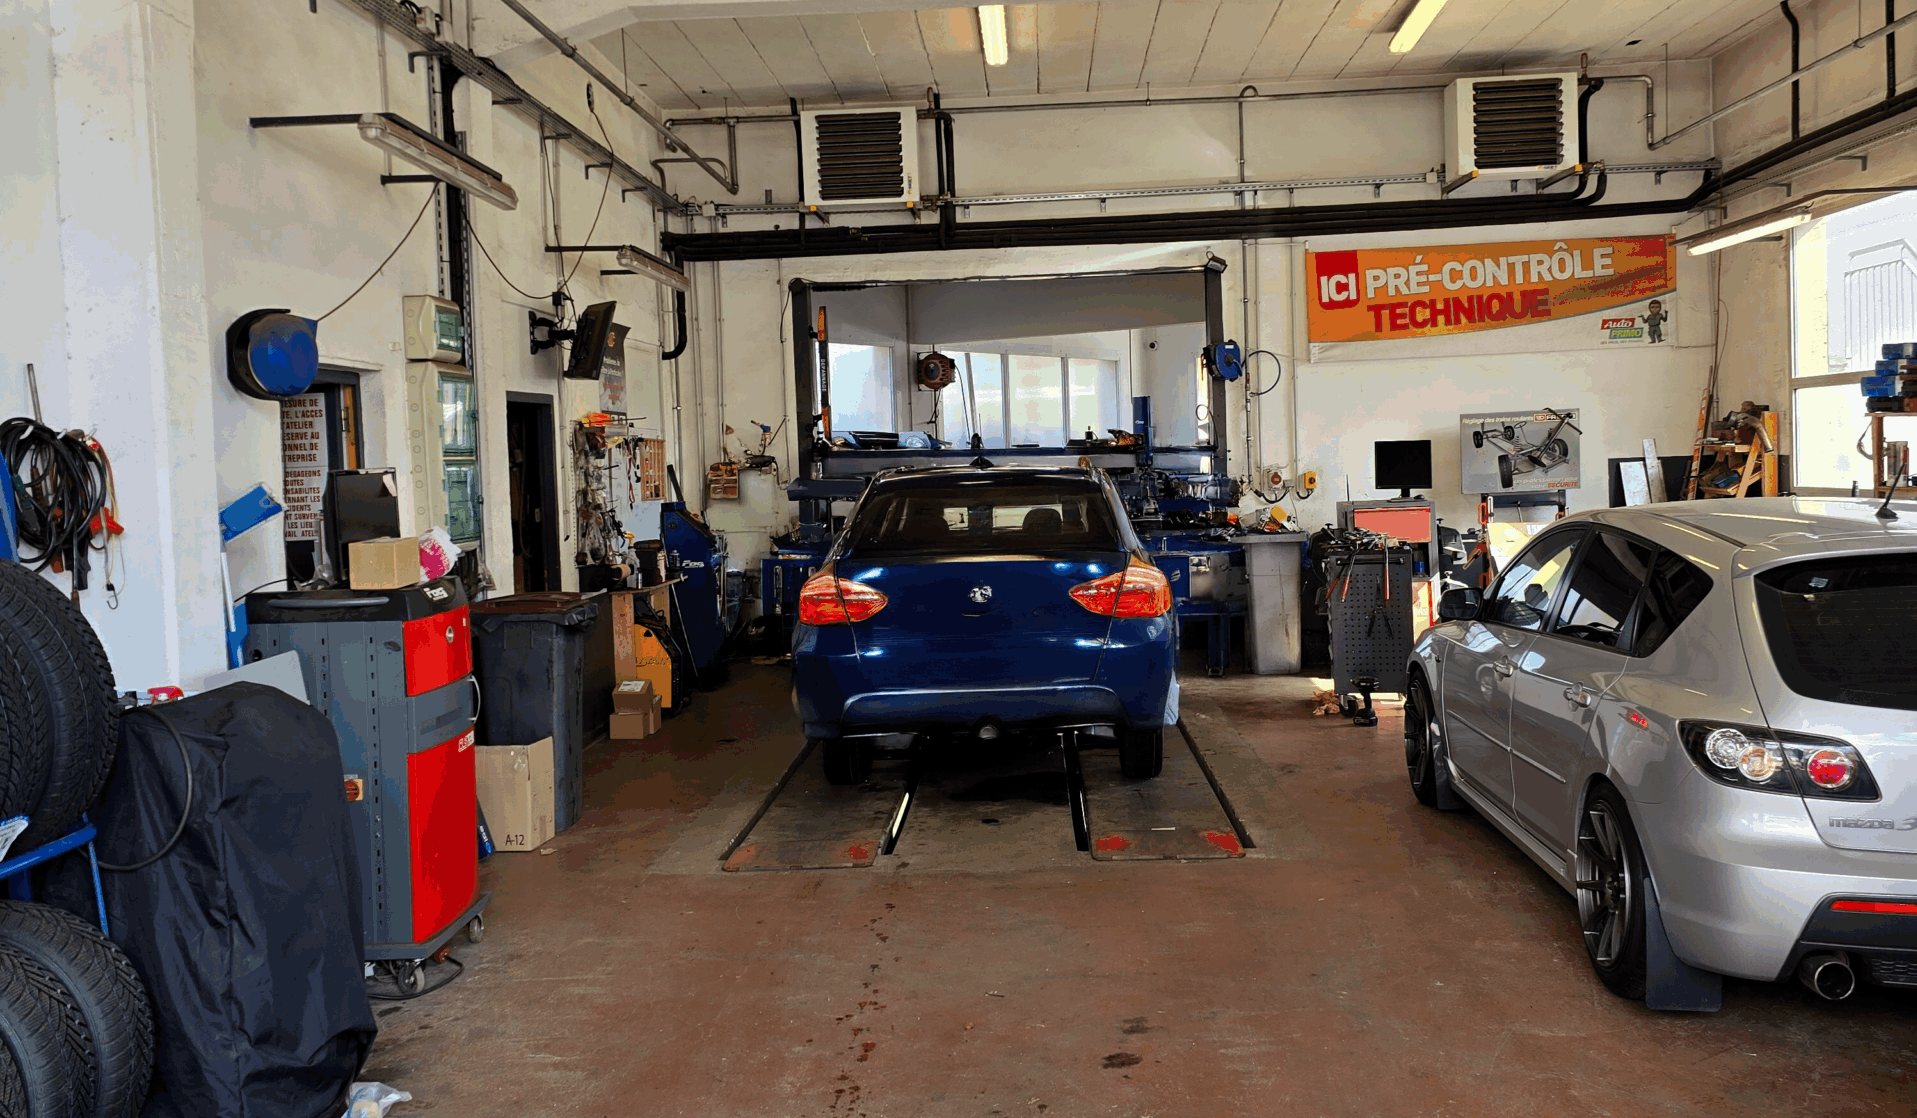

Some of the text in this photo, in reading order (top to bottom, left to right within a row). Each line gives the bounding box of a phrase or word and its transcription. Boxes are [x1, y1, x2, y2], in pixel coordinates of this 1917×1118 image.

[1320, 242, 1615, 303] ICI PRÉ-CONTRÔLE
[1367, 288, 1551, 333] TECHNIQUE
[283, 399, 319, 408] ESURE DE
[295, 409, 323, 418] L'ACCES
[282, 421, 313, 430] 'ATELIER
[283, 432, 320, 441] ESERVE AU
[283, 442, 319, 452] ONNEL DE
[286, 487, 320, 495] NSABILITES
[505, 833, 525, 846] A-12
